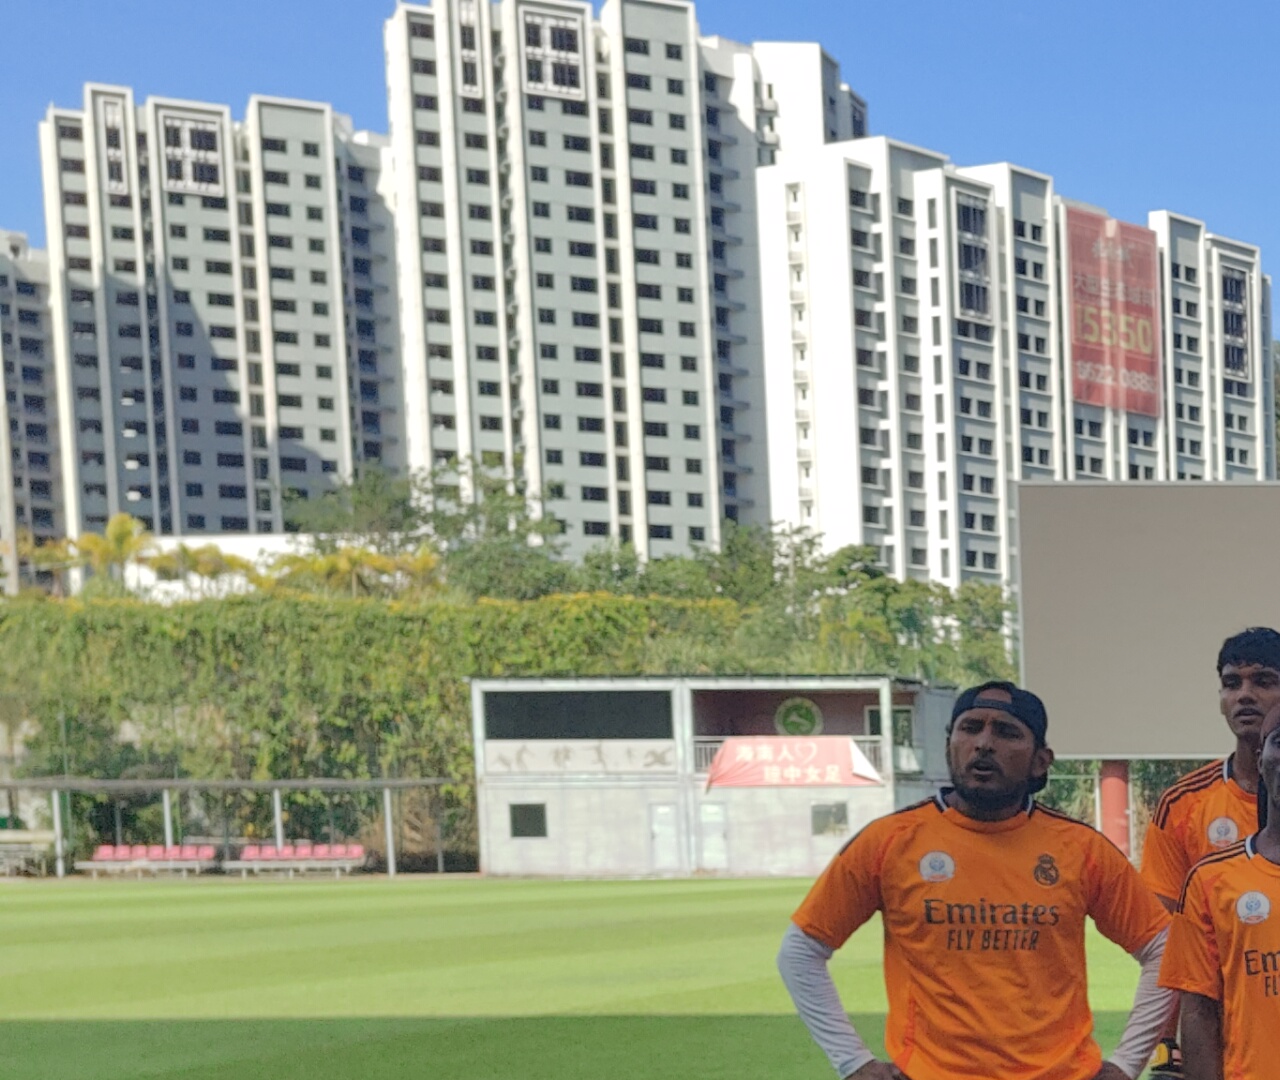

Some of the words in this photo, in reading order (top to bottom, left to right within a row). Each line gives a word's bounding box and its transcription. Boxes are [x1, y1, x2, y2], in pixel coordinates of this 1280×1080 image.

[923, 897, 1060, 926] Emirates
[947, 928, 975, 950] FLY
[980, 928, 1040, 950] BETTER
